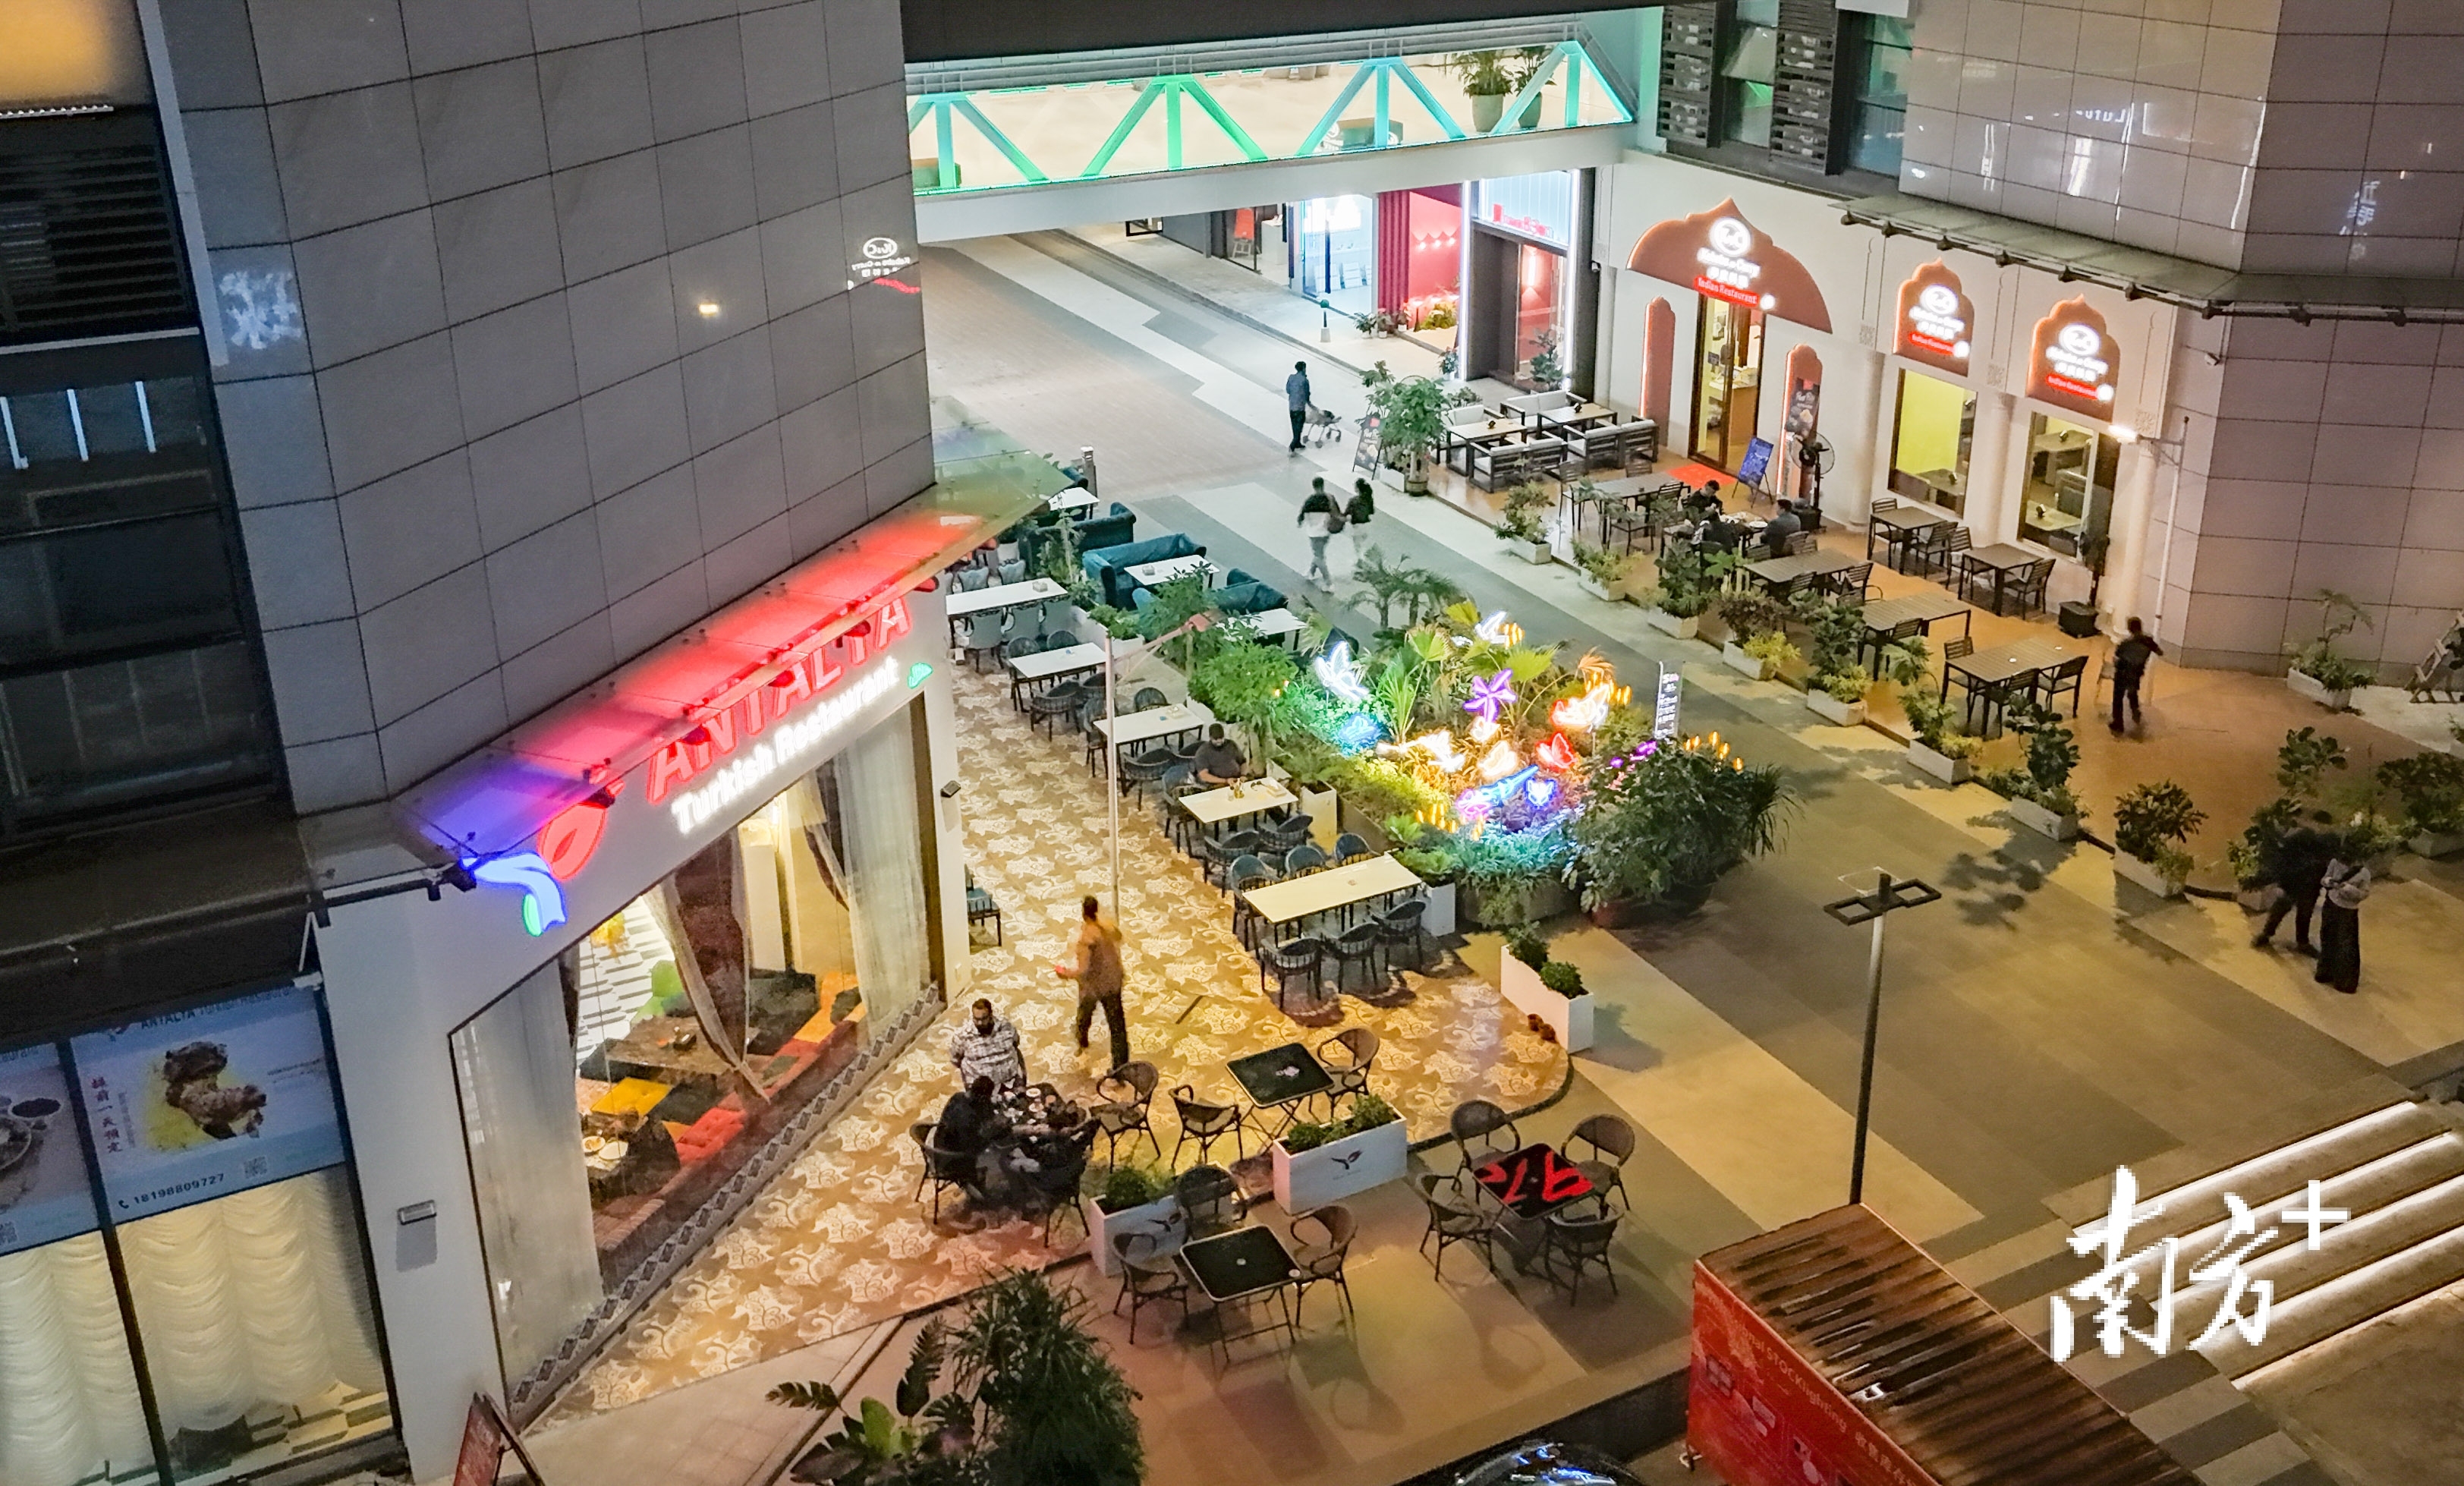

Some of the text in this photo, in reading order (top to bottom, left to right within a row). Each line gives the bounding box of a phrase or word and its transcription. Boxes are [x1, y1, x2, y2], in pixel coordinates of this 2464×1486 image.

[1698, 277, 1719, 293] Indian
[672, 655, 901, 835] Turkish Restaurant
[134, 1173, 225, 1204] 18198809727
